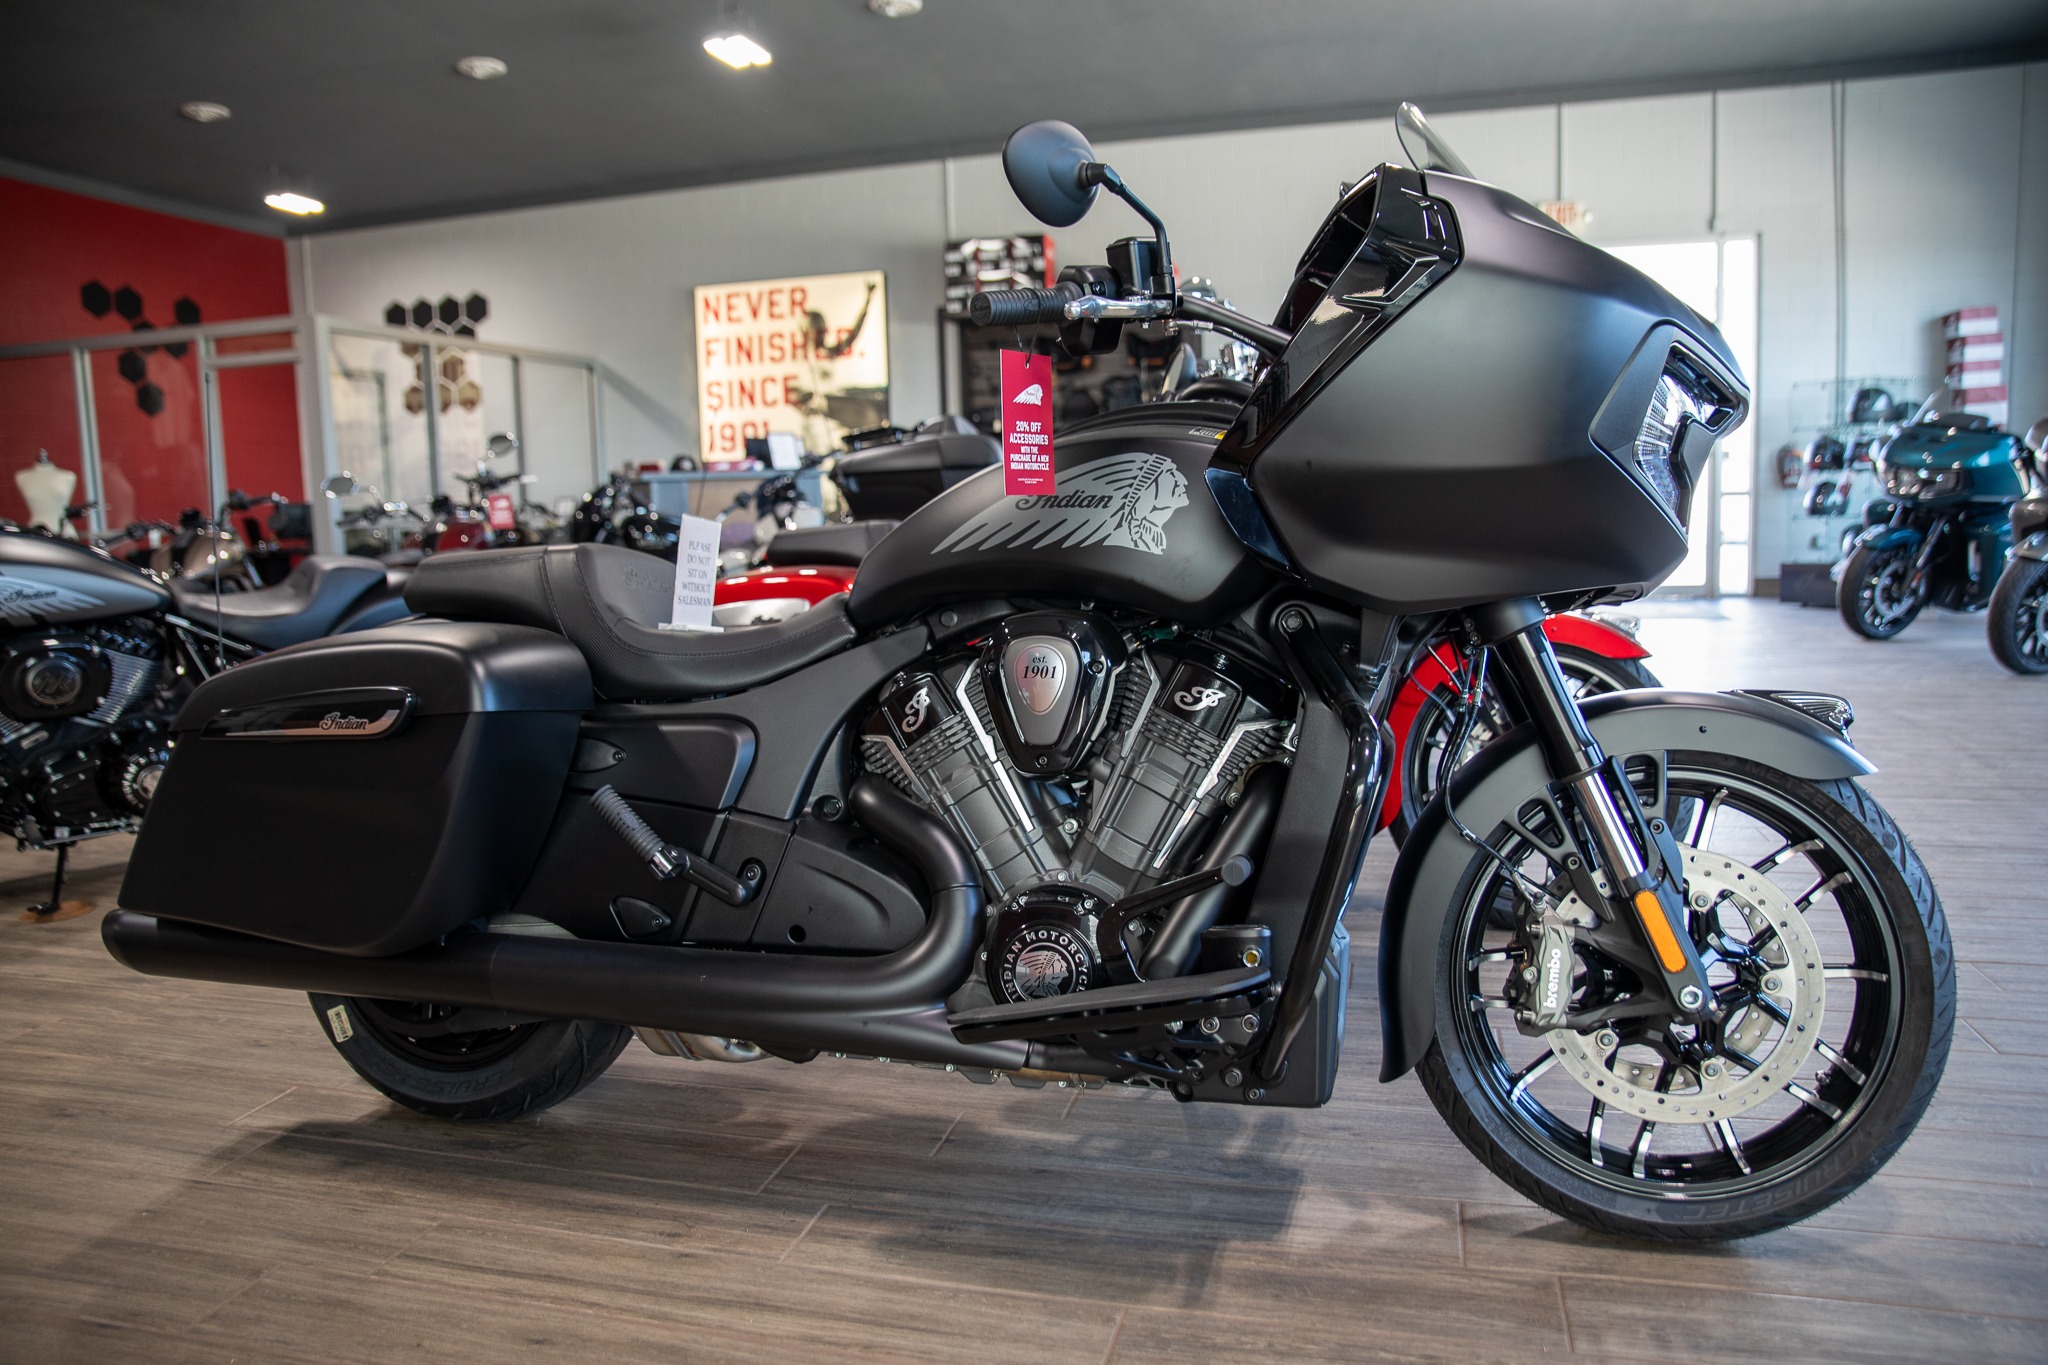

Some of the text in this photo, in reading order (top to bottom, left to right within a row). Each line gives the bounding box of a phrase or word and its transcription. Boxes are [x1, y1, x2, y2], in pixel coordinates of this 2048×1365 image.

[703, 287, 809, 325] NEVER
[706, 374, 803, 412] SINCE
[1015, 420, 1042, 433] 20% OFF
[1009, 432, 1049, 446] ACCESSORIES
[1020, 445, 1039, 454] WITH THE
[1010, 453, 1031, 462] PURCHASE
[1040, 454, 1050, 463] NEW
[1010, 462, 1050, 471] INDIAN MOTORCYCLE
[1015, 489, 1114, 511] Indian
[688, 540, 712, 553] PLEASE
[686, 554, 711, 566] DO NOT
[687, 568, 708, 579] SIT ON
[681, 581, 711, 593] WITHOUT
[677, 594, 711, 606] SALESMAN
[1032, 655, 1048, 664] est.
[1022, 664, 1057, 680] 1901
[319, 711, 369, 731] Indian
[1003, 929, 1089, 999] INDIAN MOTORCYCL
[1542, 948, 1562, 1008] brembo
